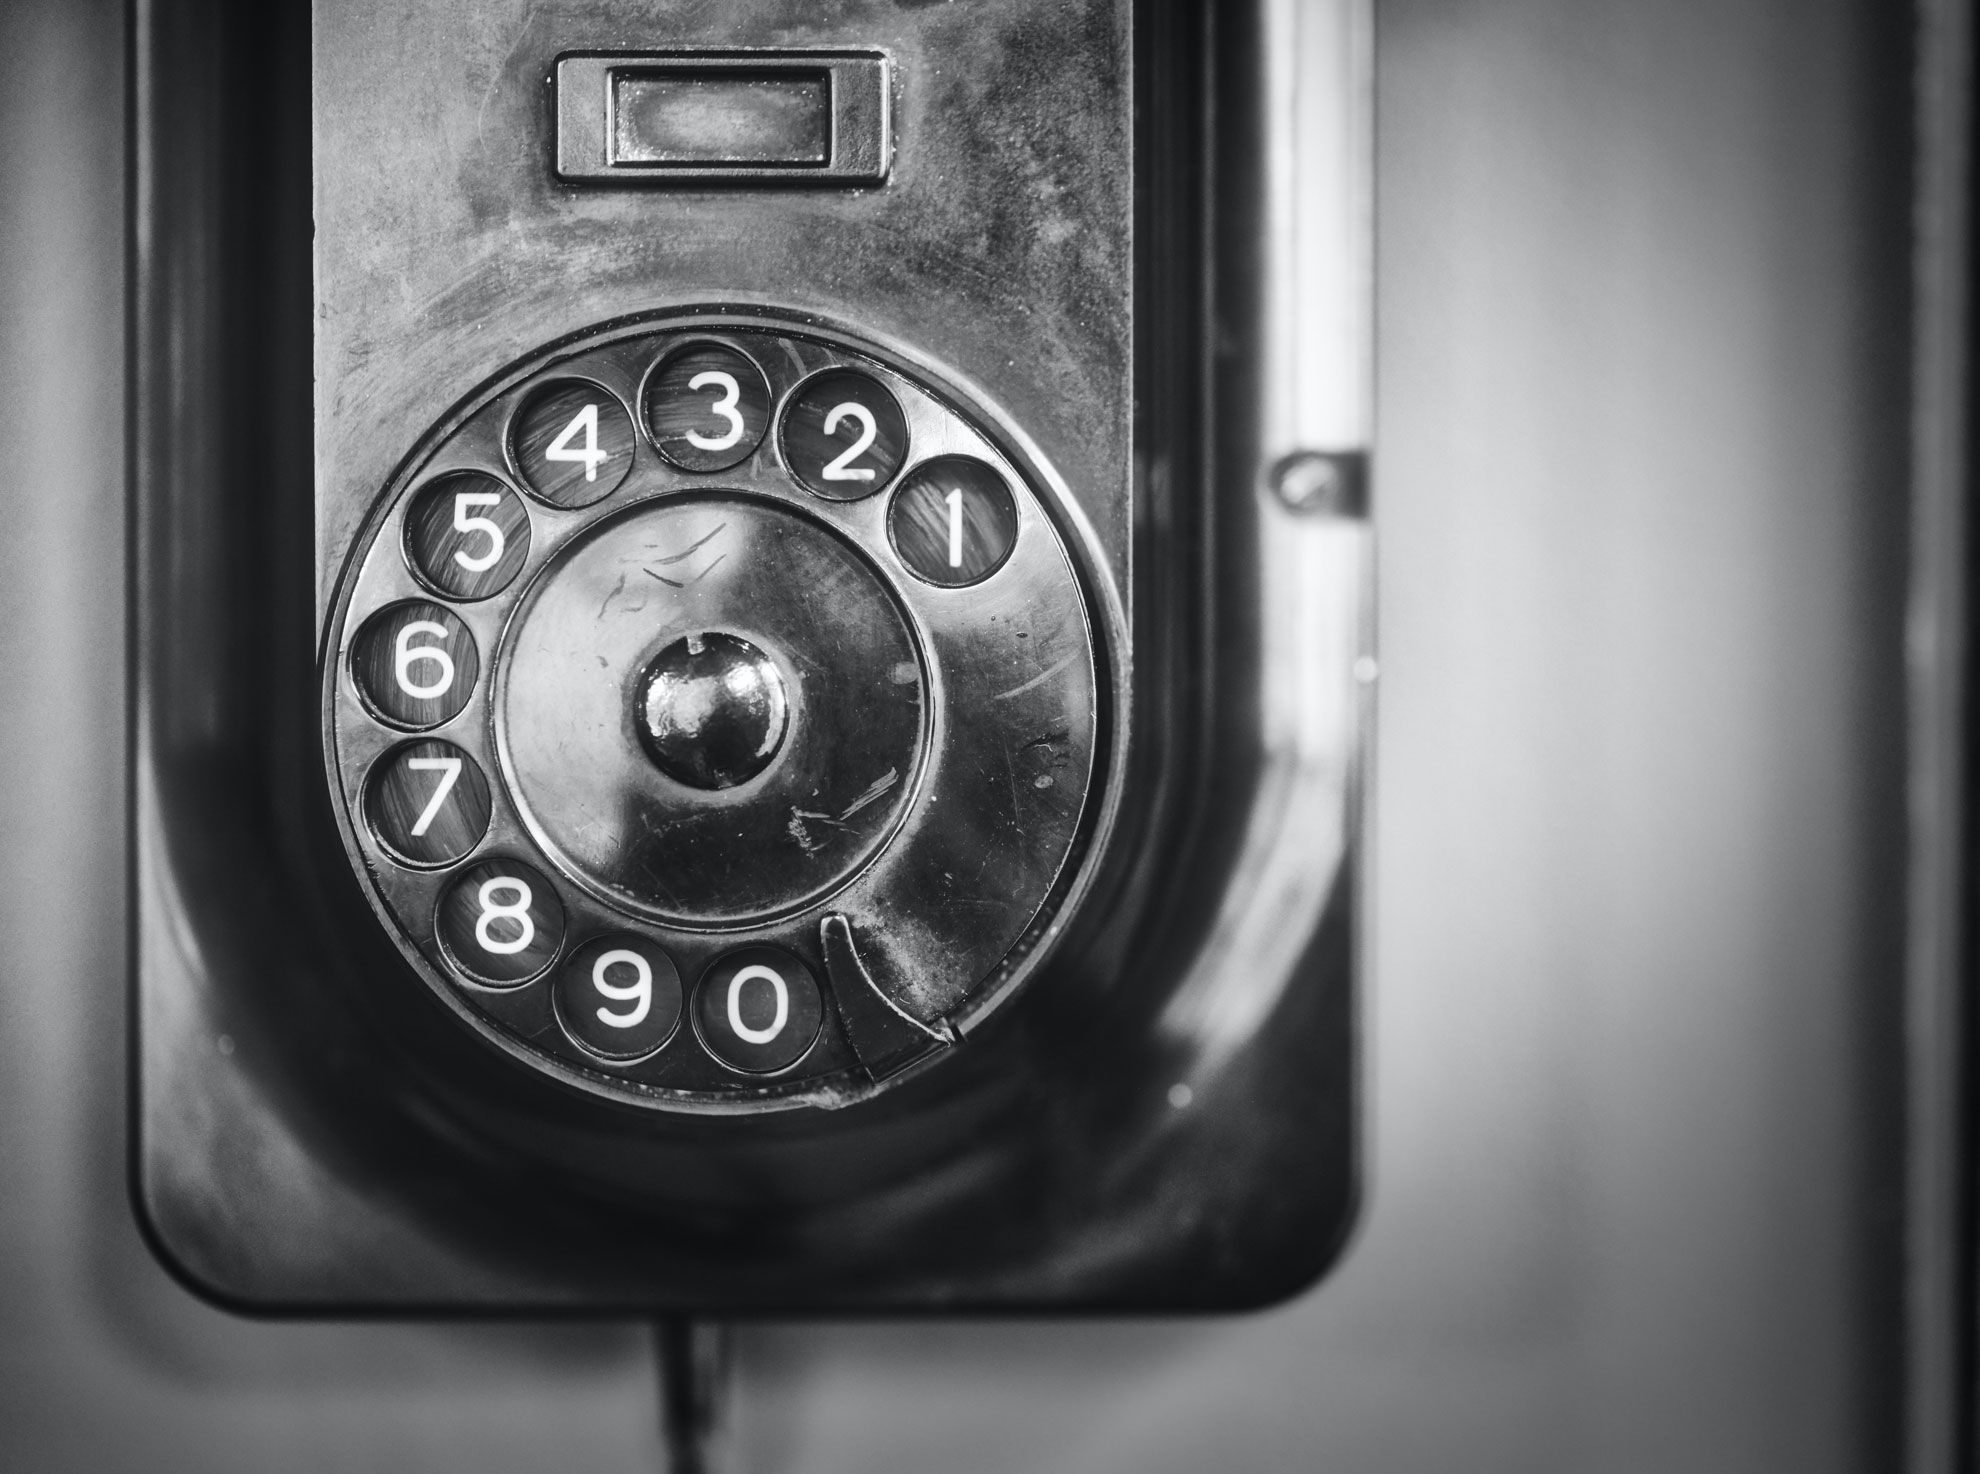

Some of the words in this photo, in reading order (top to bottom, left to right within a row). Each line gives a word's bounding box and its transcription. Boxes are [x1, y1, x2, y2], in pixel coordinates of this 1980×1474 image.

[545, 404, 613, 482] 4
[682, 371, 745, 451] 3
[822, 402, 877, 481] 2
[453, 492, 506, 573] 5
[943, 487, 964, 568] 1
[394, 620, 455, 700] 6
[408, 757, 462, 837] 7
[475, 876, 535, 954] 8
[592, 950, 653, 1028] 9
[727, 965, 789, 1044] 0
